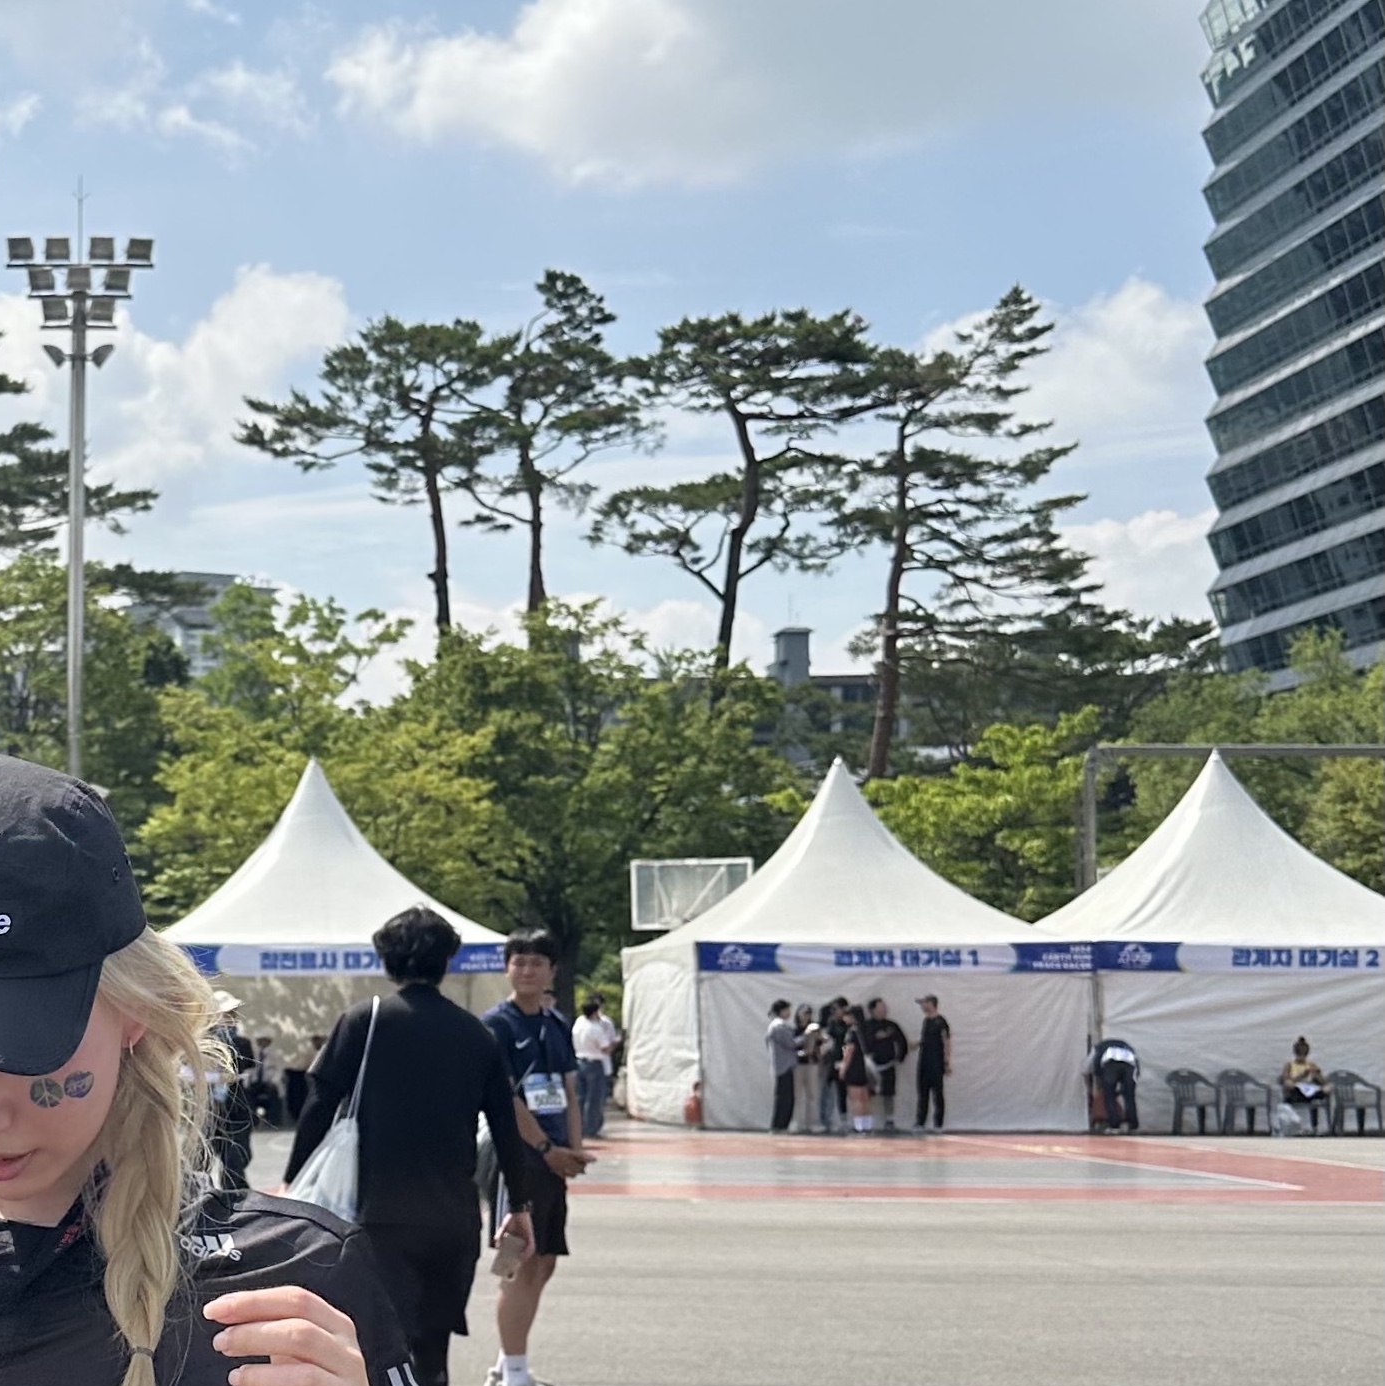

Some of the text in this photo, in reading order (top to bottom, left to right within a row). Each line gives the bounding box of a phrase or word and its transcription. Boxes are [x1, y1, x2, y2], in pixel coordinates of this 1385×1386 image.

[344, 951, 383, 970] 대기
[901, 949, 961, 967] 대기실
[968, 949, 979, 966] 1
[1232, 948, 1379, 967] 관계자 대기실 2
[179, 1236, 243, 1262] adis
